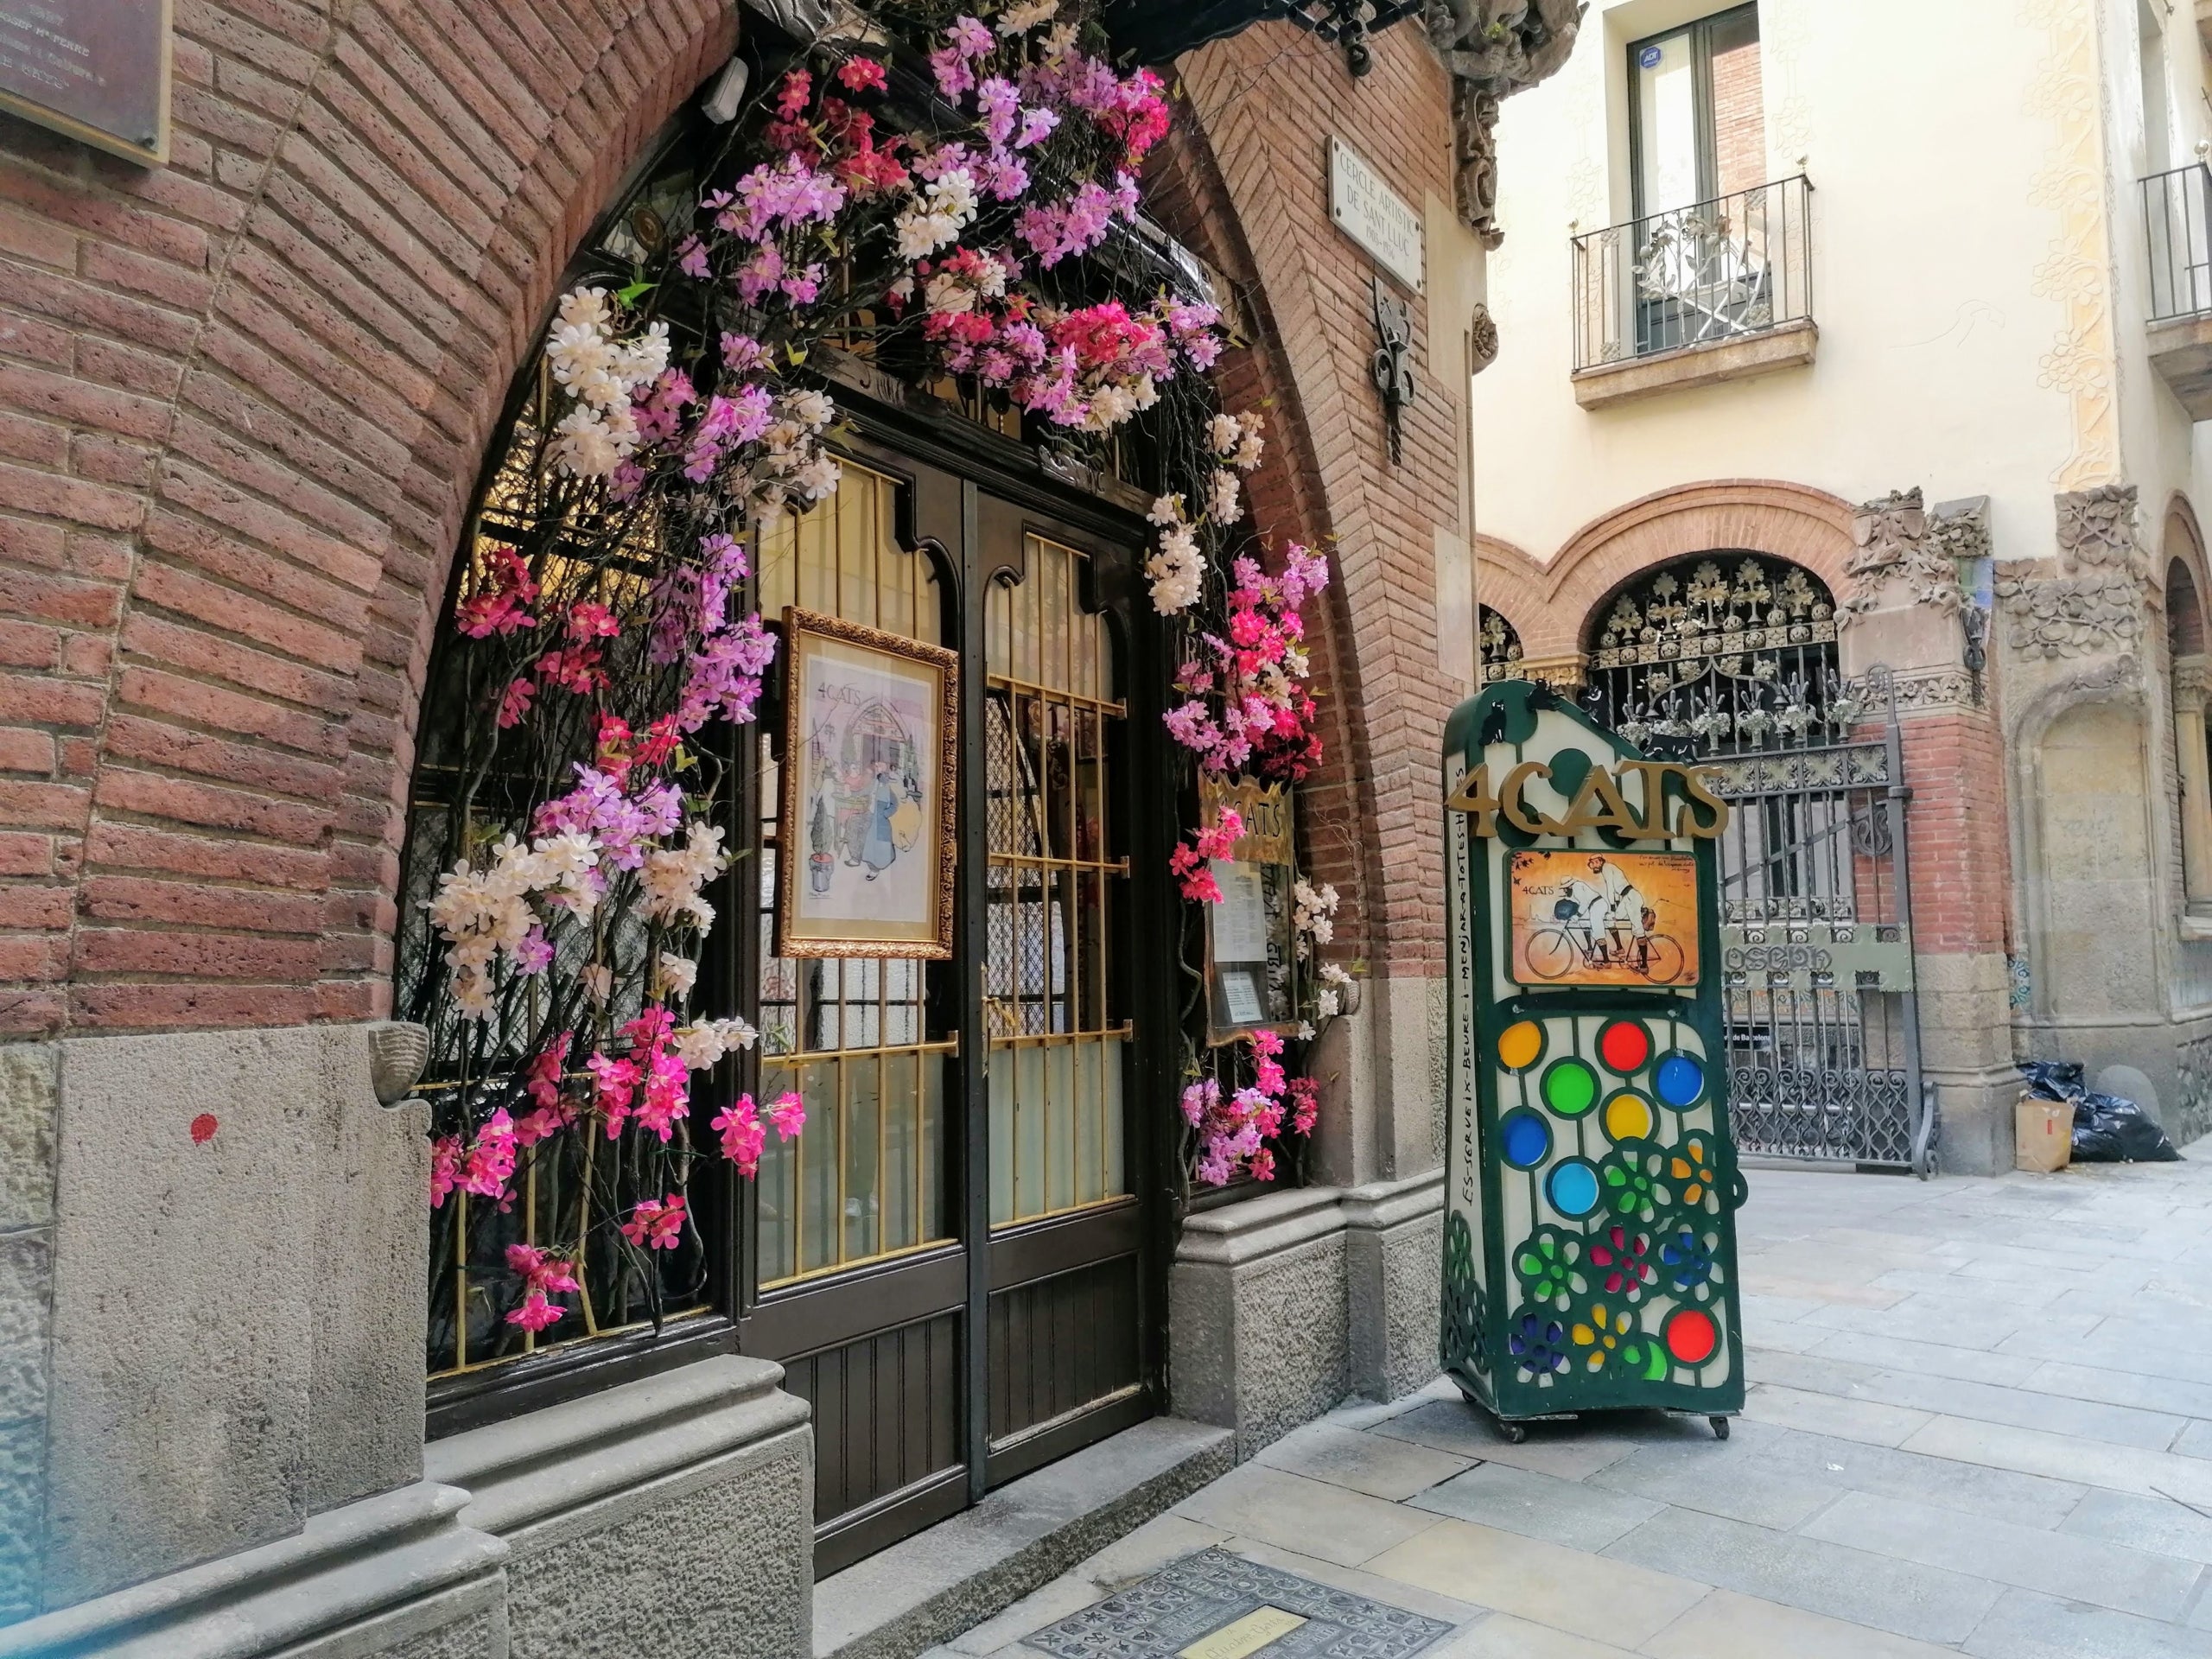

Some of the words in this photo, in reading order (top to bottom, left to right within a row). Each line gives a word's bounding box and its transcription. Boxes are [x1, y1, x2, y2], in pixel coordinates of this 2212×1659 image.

[1339, 152, 1376, 200] CERCLE
[1347, 185, 1360, 213] DE
[1363, 200, 1386, 232] SANT
[1388, 223, 1410, 257] LLUC
[1444, 760, 1729, 839] 4CATS
[1741, 1033, 1770, 1042] Bacelona
